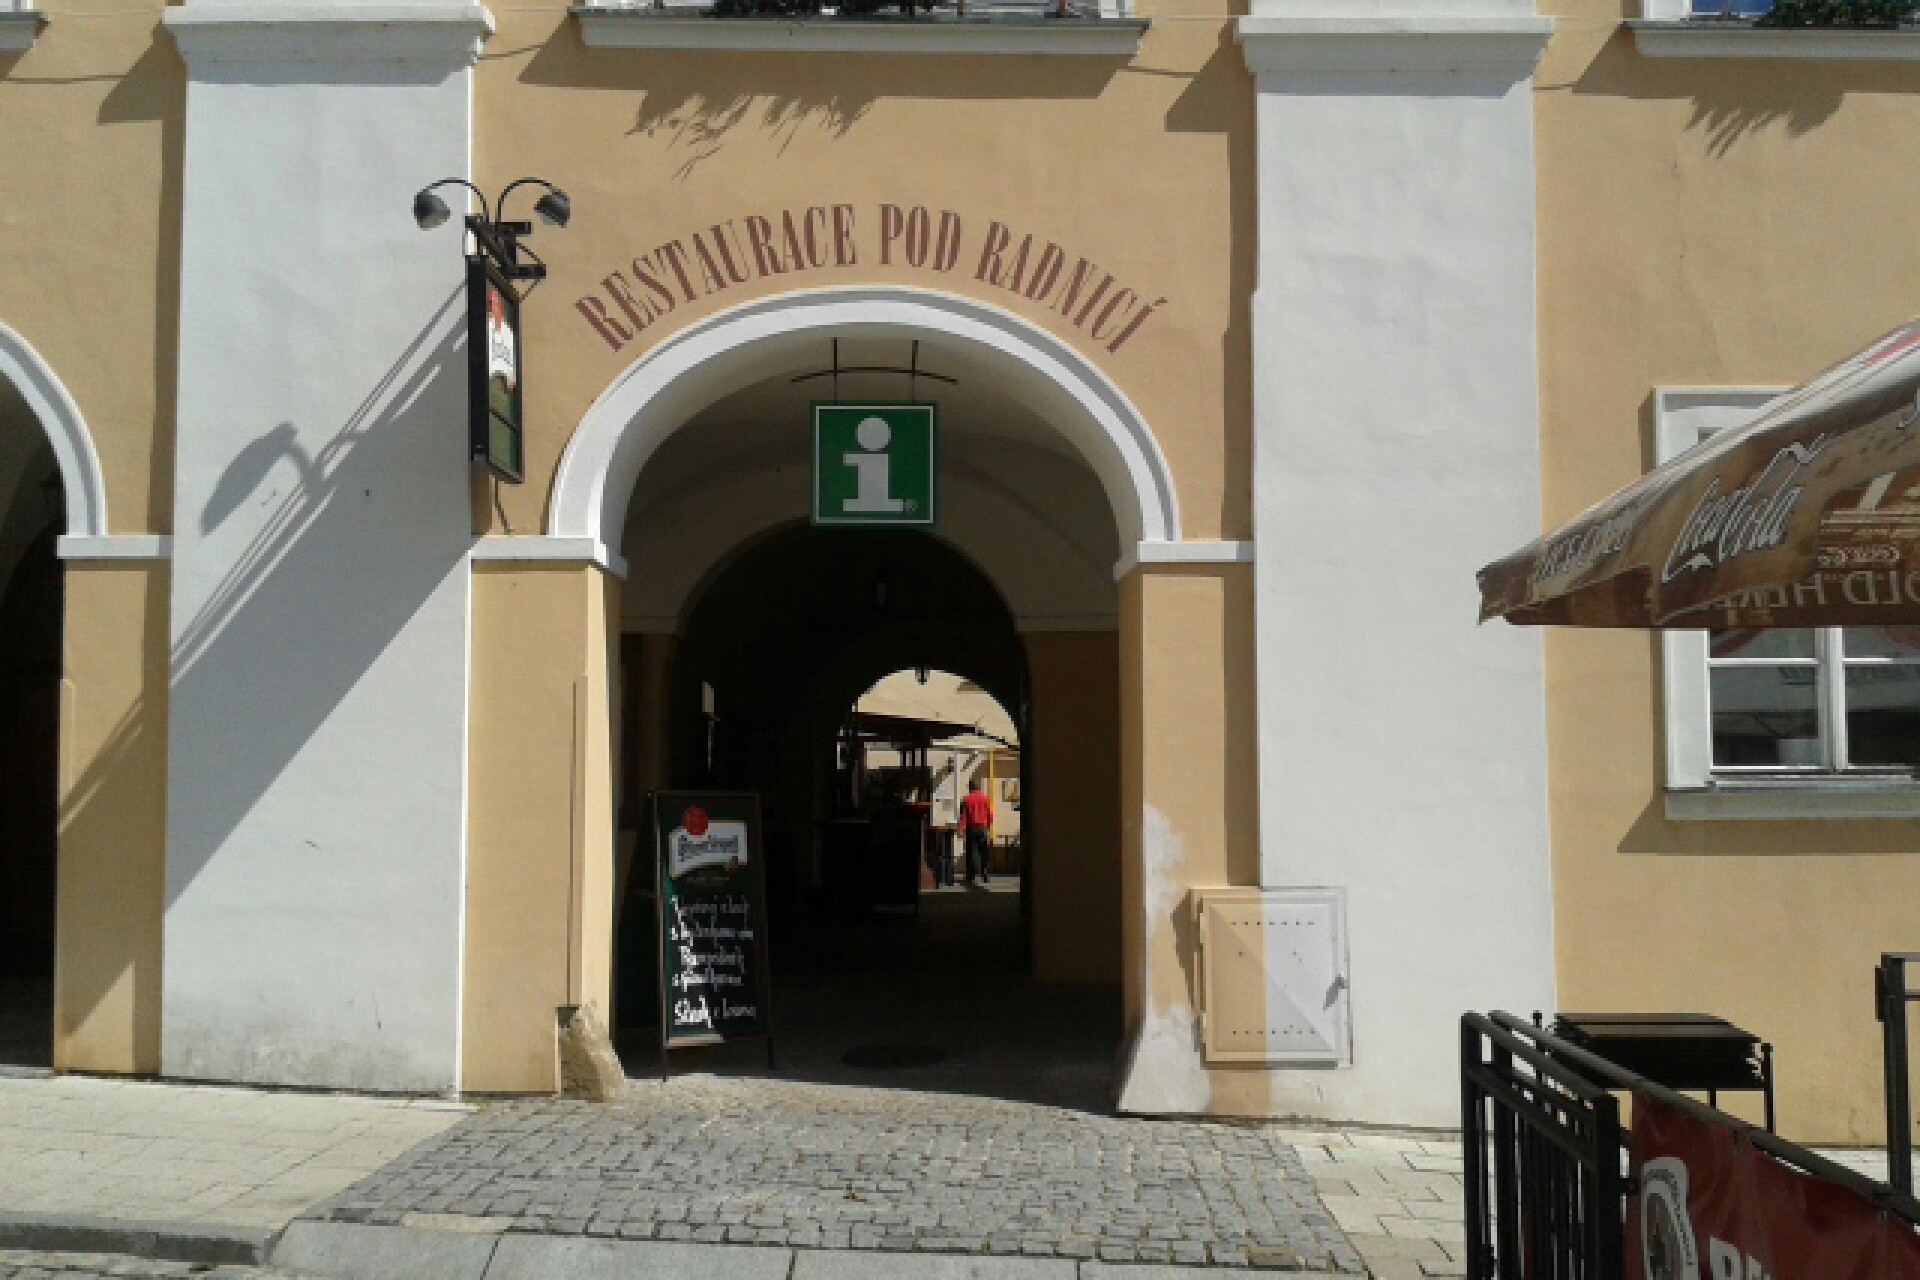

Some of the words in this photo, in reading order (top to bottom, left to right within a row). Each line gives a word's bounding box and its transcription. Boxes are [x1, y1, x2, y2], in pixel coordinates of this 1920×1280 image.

[575, 203, 857, 353] RESTAURACE
[878, 203, 962, 273] POD
[973, 220, 1167, 353] RADNICÍ
